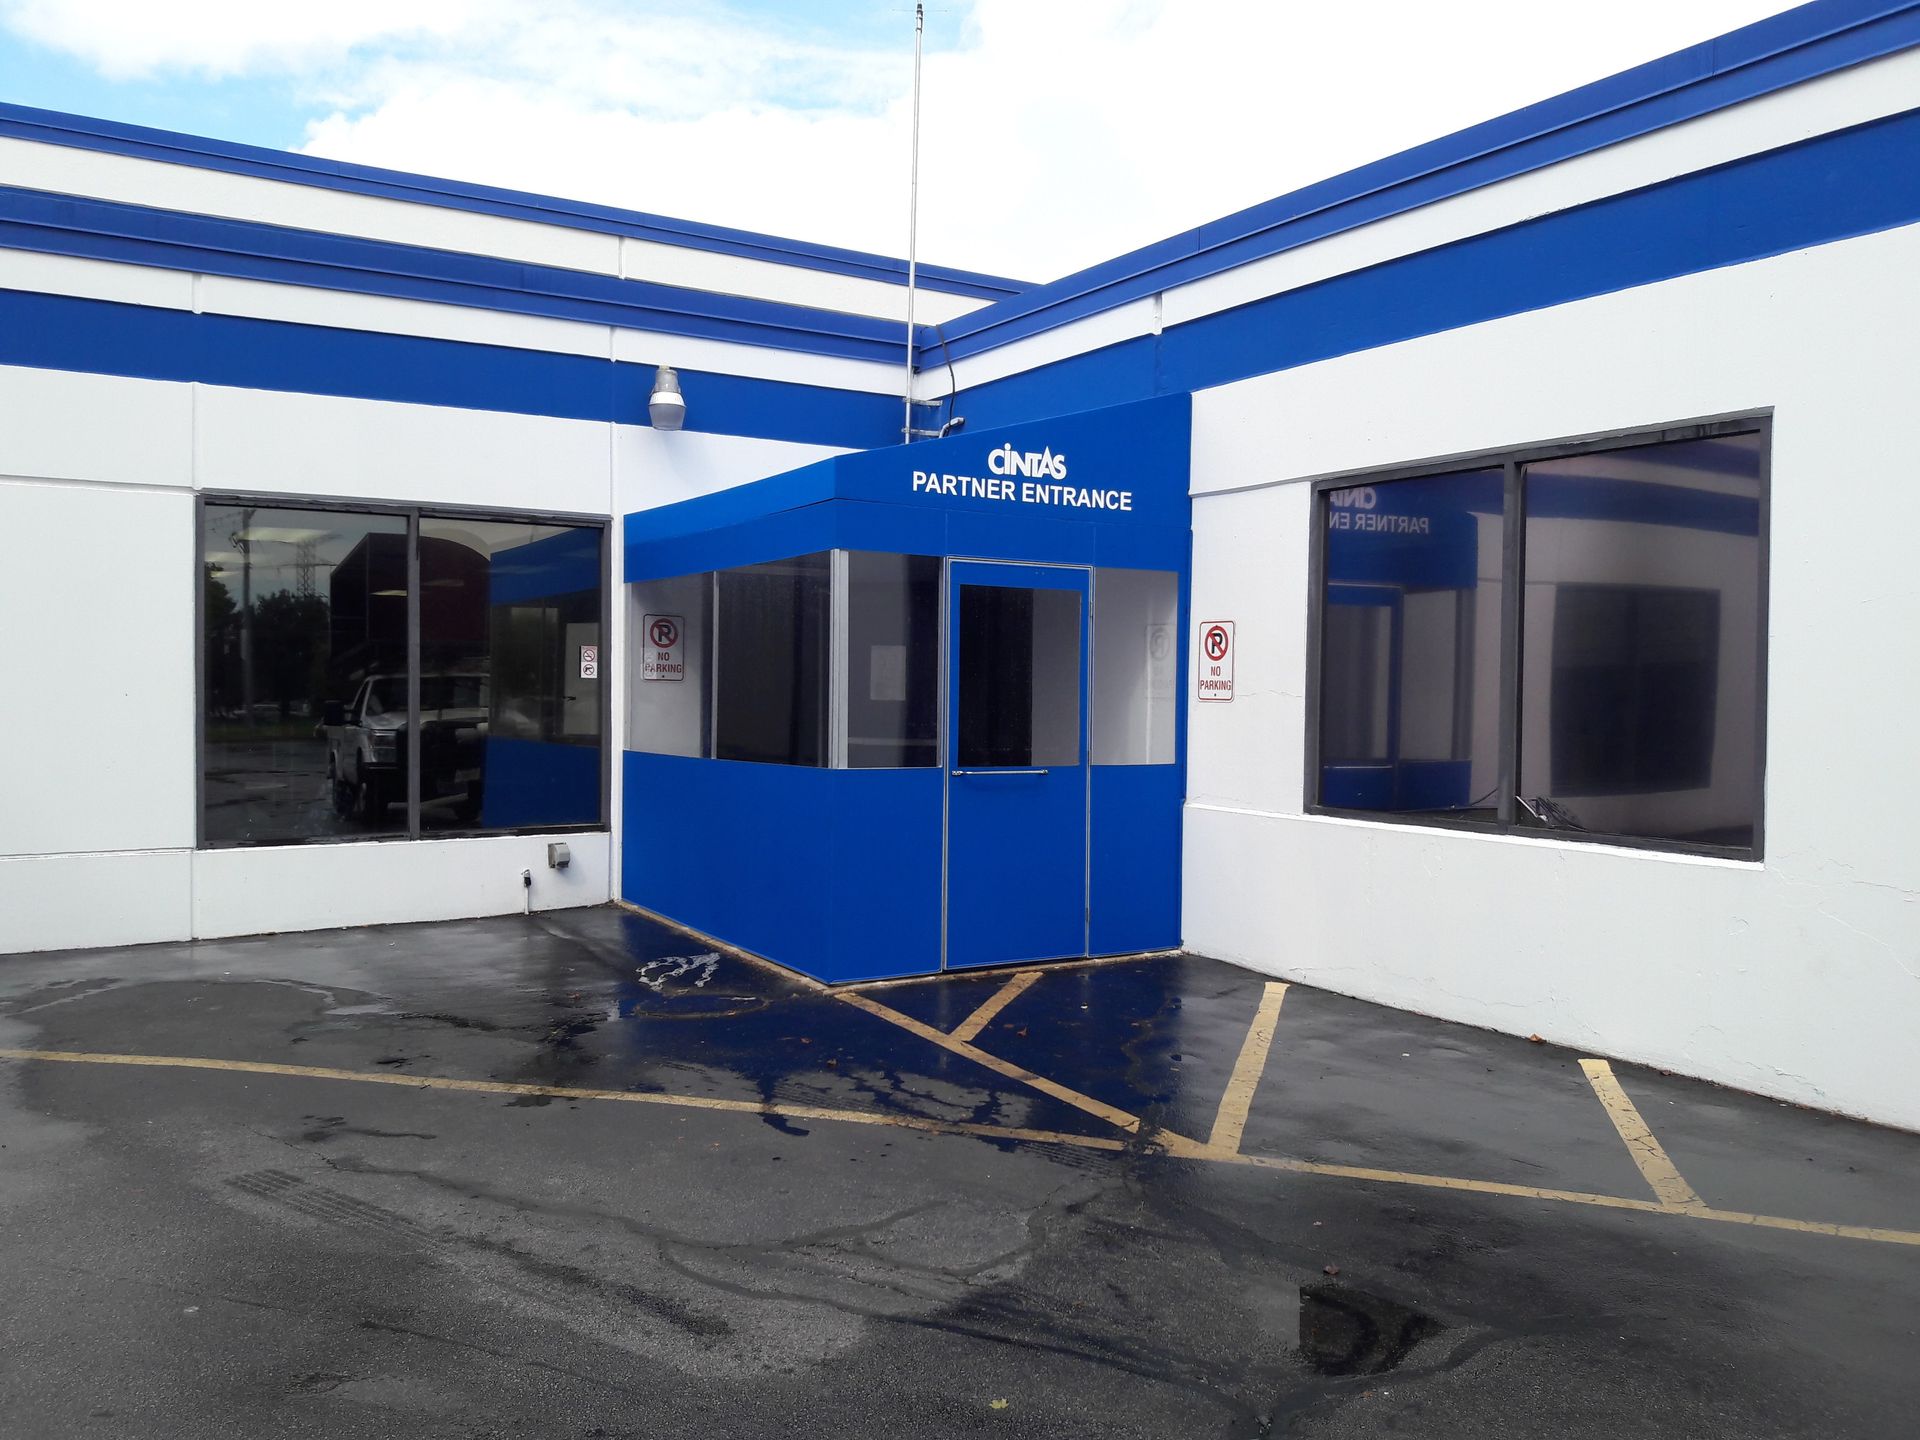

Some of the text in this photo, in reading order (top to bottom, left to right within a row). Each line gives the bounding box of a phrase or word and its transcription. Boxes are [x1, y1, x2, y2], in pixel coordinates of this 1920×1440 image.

[912, 471, 1132, 511] PARTNER ENTRANCE
[657, 652, 670, 661] NO
[645, 664, 682, 673] PARKING
[1210, 666, 1221, 676] NO
[1200, 680, 1231, 691] PARKING
